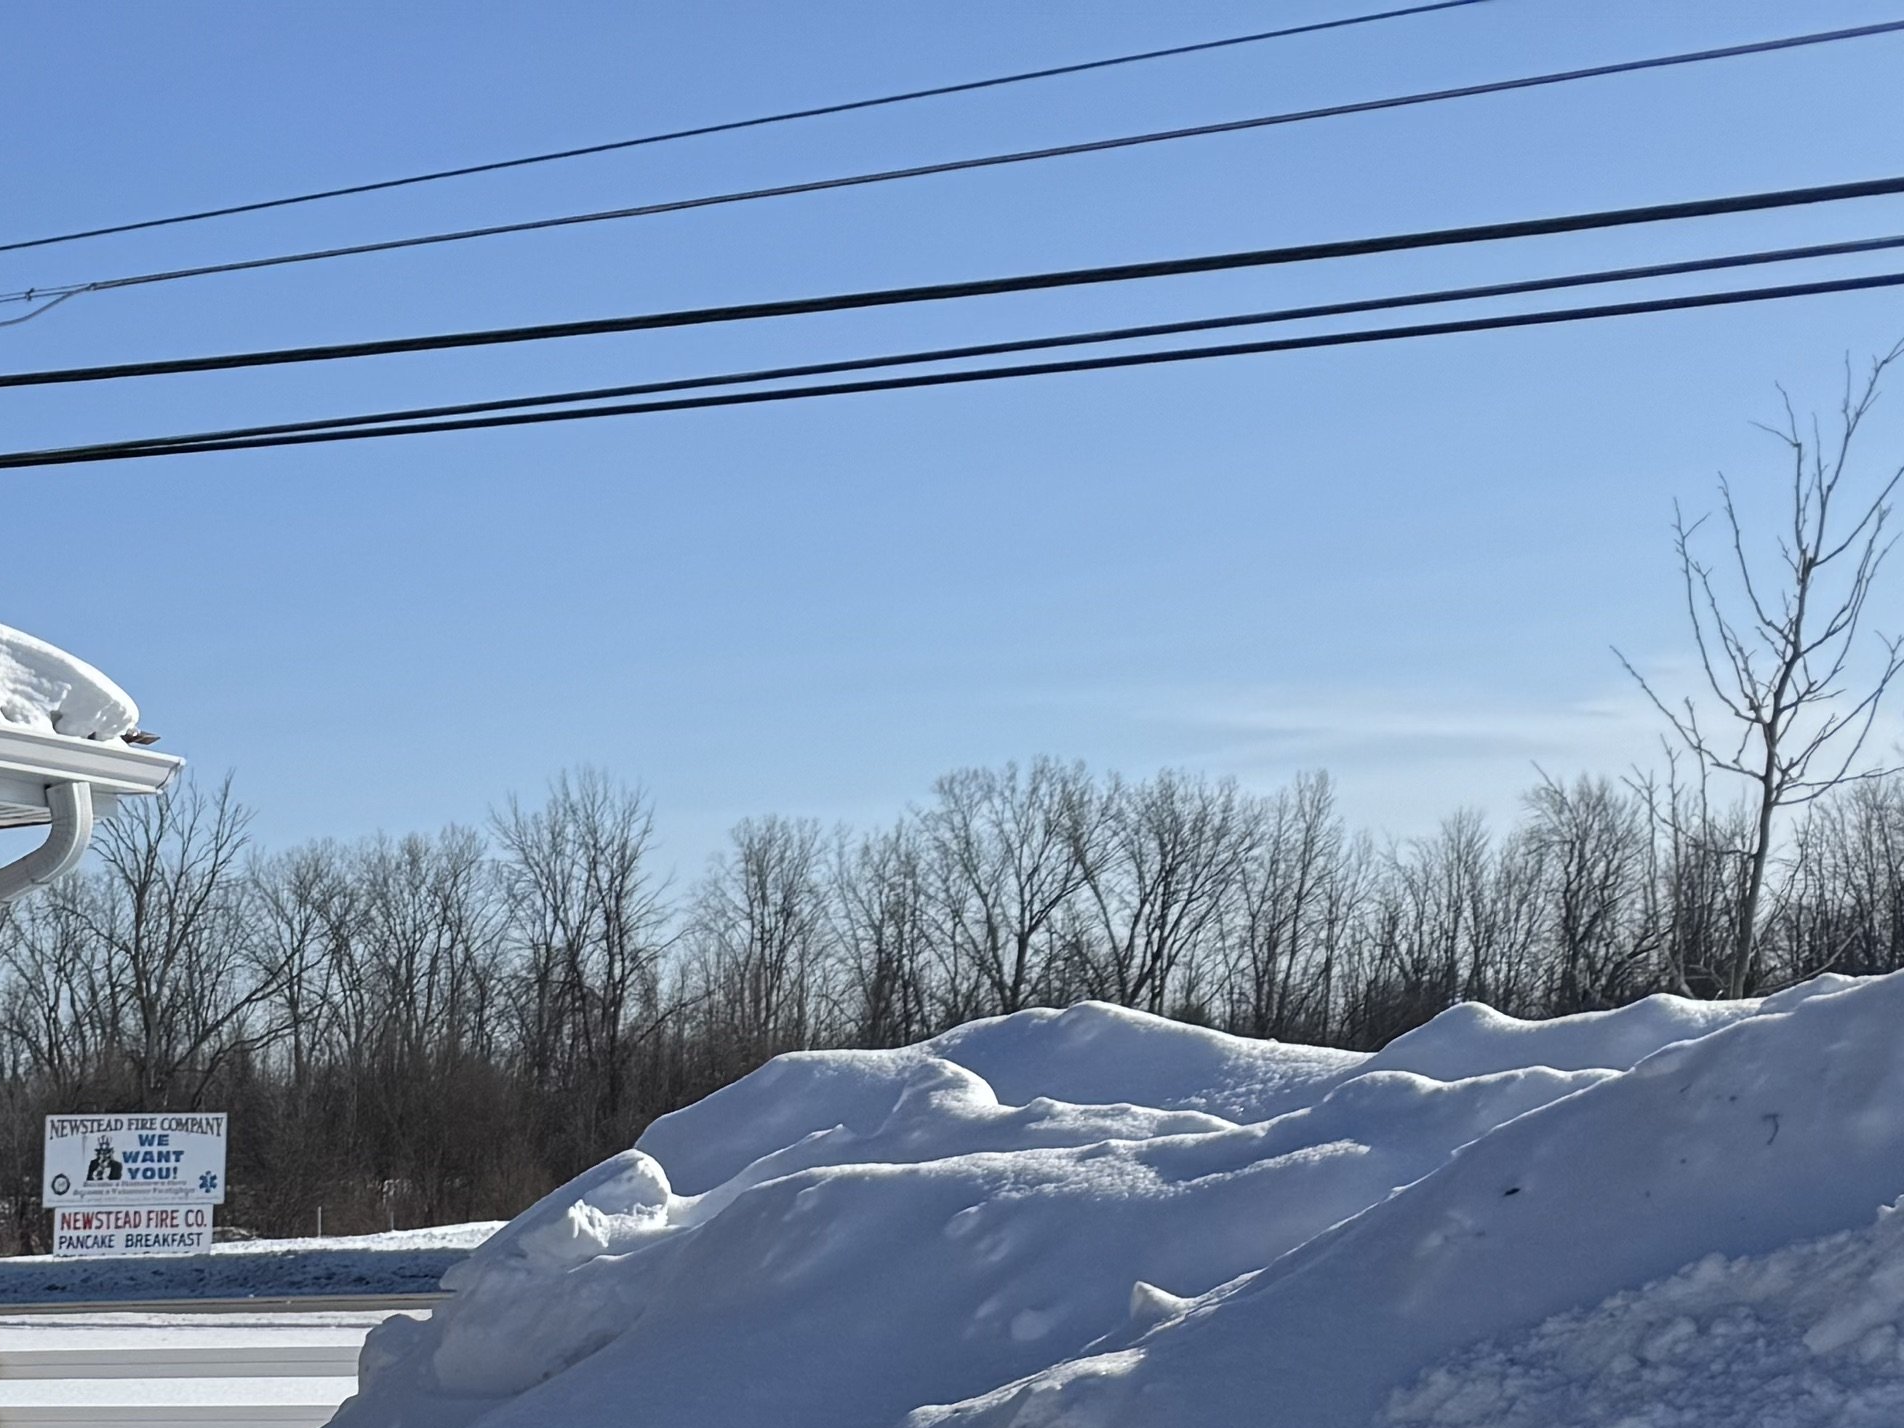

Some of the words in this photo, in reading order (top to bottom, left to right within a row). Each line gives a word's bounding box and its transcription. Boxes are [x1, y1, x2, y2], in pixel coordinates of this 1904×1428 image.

[50, 1118, 123, 1140] NEWSTEAD
[128, 1117, 157, 1131] FIRE
[160, 1117, 224, 1137] COMPANY
[138, 1133, 169, 1147] WE
[122, 1150, 184, 1163] WANT
[128, 1167, 178, 1180] YOU!
[61, 1210, 142, 1231] NEWSTEAD
[146, 1209, 179, 1229] FIRE
[184, 1209, 207, 1228] CO.
[58, 1234, 115, 1250] PANCAKE
[125, 1232, 203, 1248] BREAKFAST
